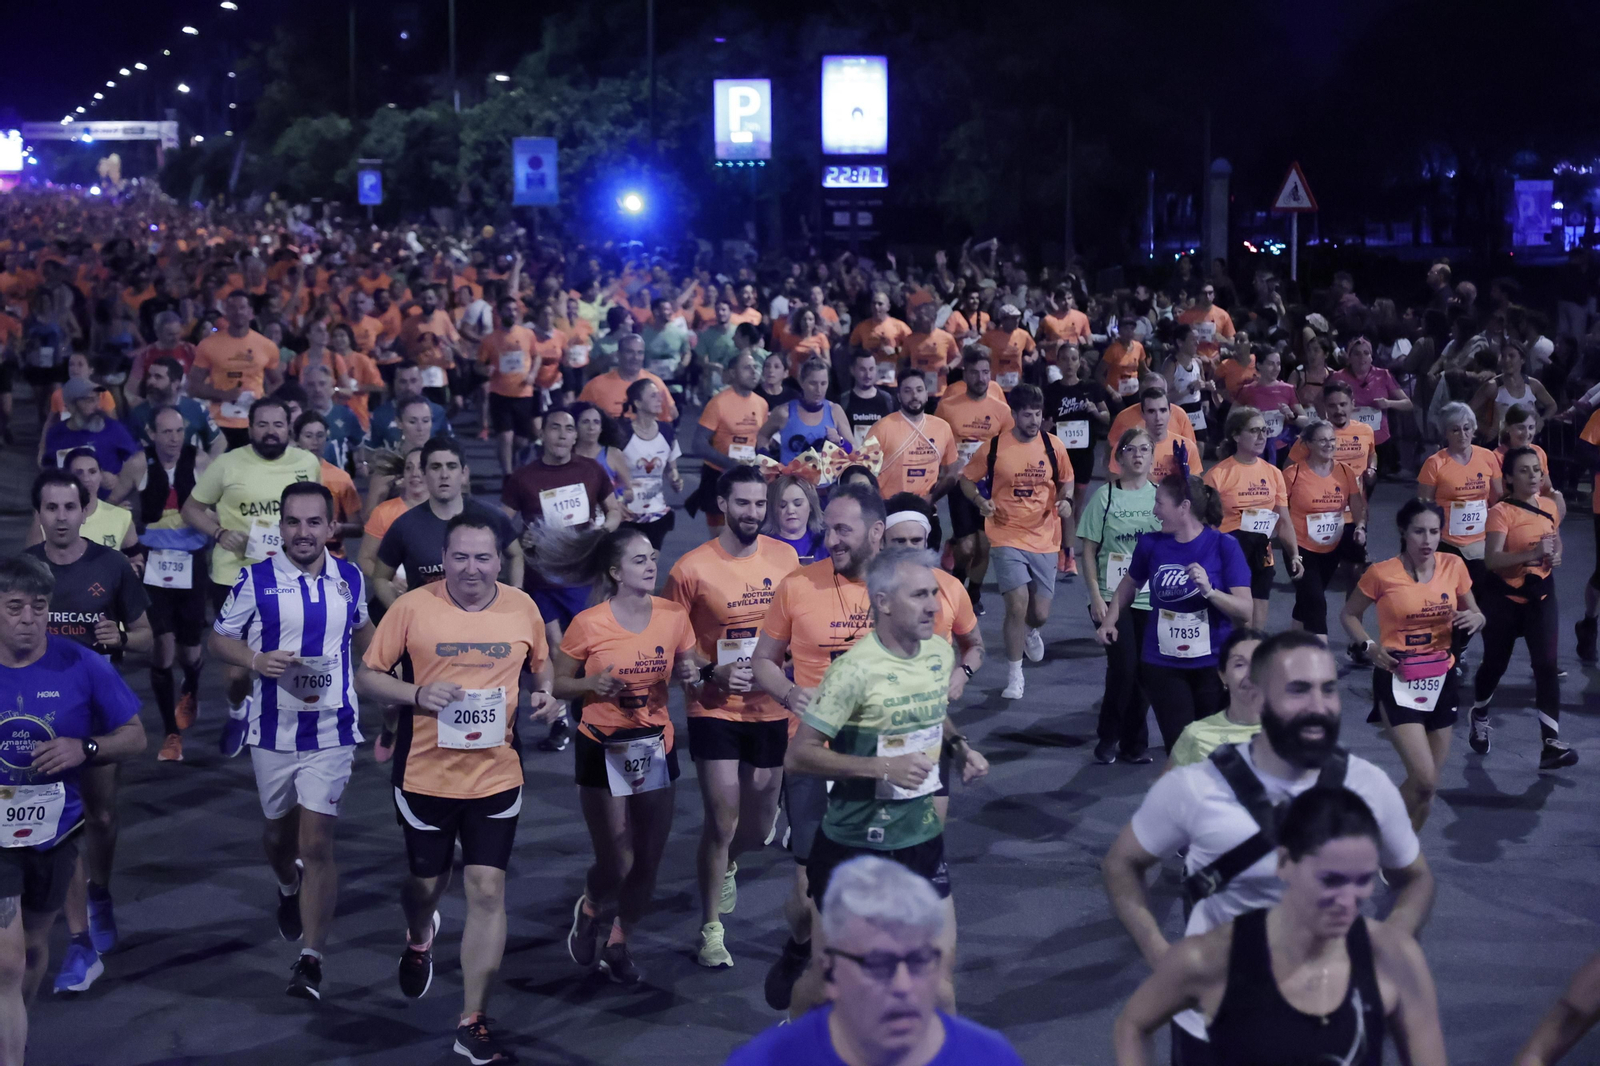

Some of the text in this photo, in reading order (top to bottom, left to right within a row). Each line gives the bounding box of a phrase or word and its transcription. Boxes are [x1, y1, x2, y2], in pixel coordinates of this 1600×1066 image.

[729, 86, 761, 132] P
[826, 166, 883, 183] 22:07
[853, 413, 881, 421] Deloitte
[553, 498, 581, 512] 11705
[1462, 513, 1480, 522] 2872
[1253, 521, 1270, 530] 2772
[1317, 523, 1339, 533] 21707
[157, 560, 184, 572] 16739
[1161, 570, 1190, 587] life
[727, 598, 758, 609] SEVILLA
[61, 625, 86, 635] Club
[830, 621, 867, 629] SEVILLA
[1169, 626, 1200, 640] 17835
[618, 665, 666, 675] SEVILLA KH7
[293, 674, 332, 689] 17609
[1407, 679, 1439, 691] 13359
[454, 708, 496, 724] 20635
[12, 729, 30, 740] edp
[624, 756, 651, 772] 8271
[6, 806, 46, 822] 9070
